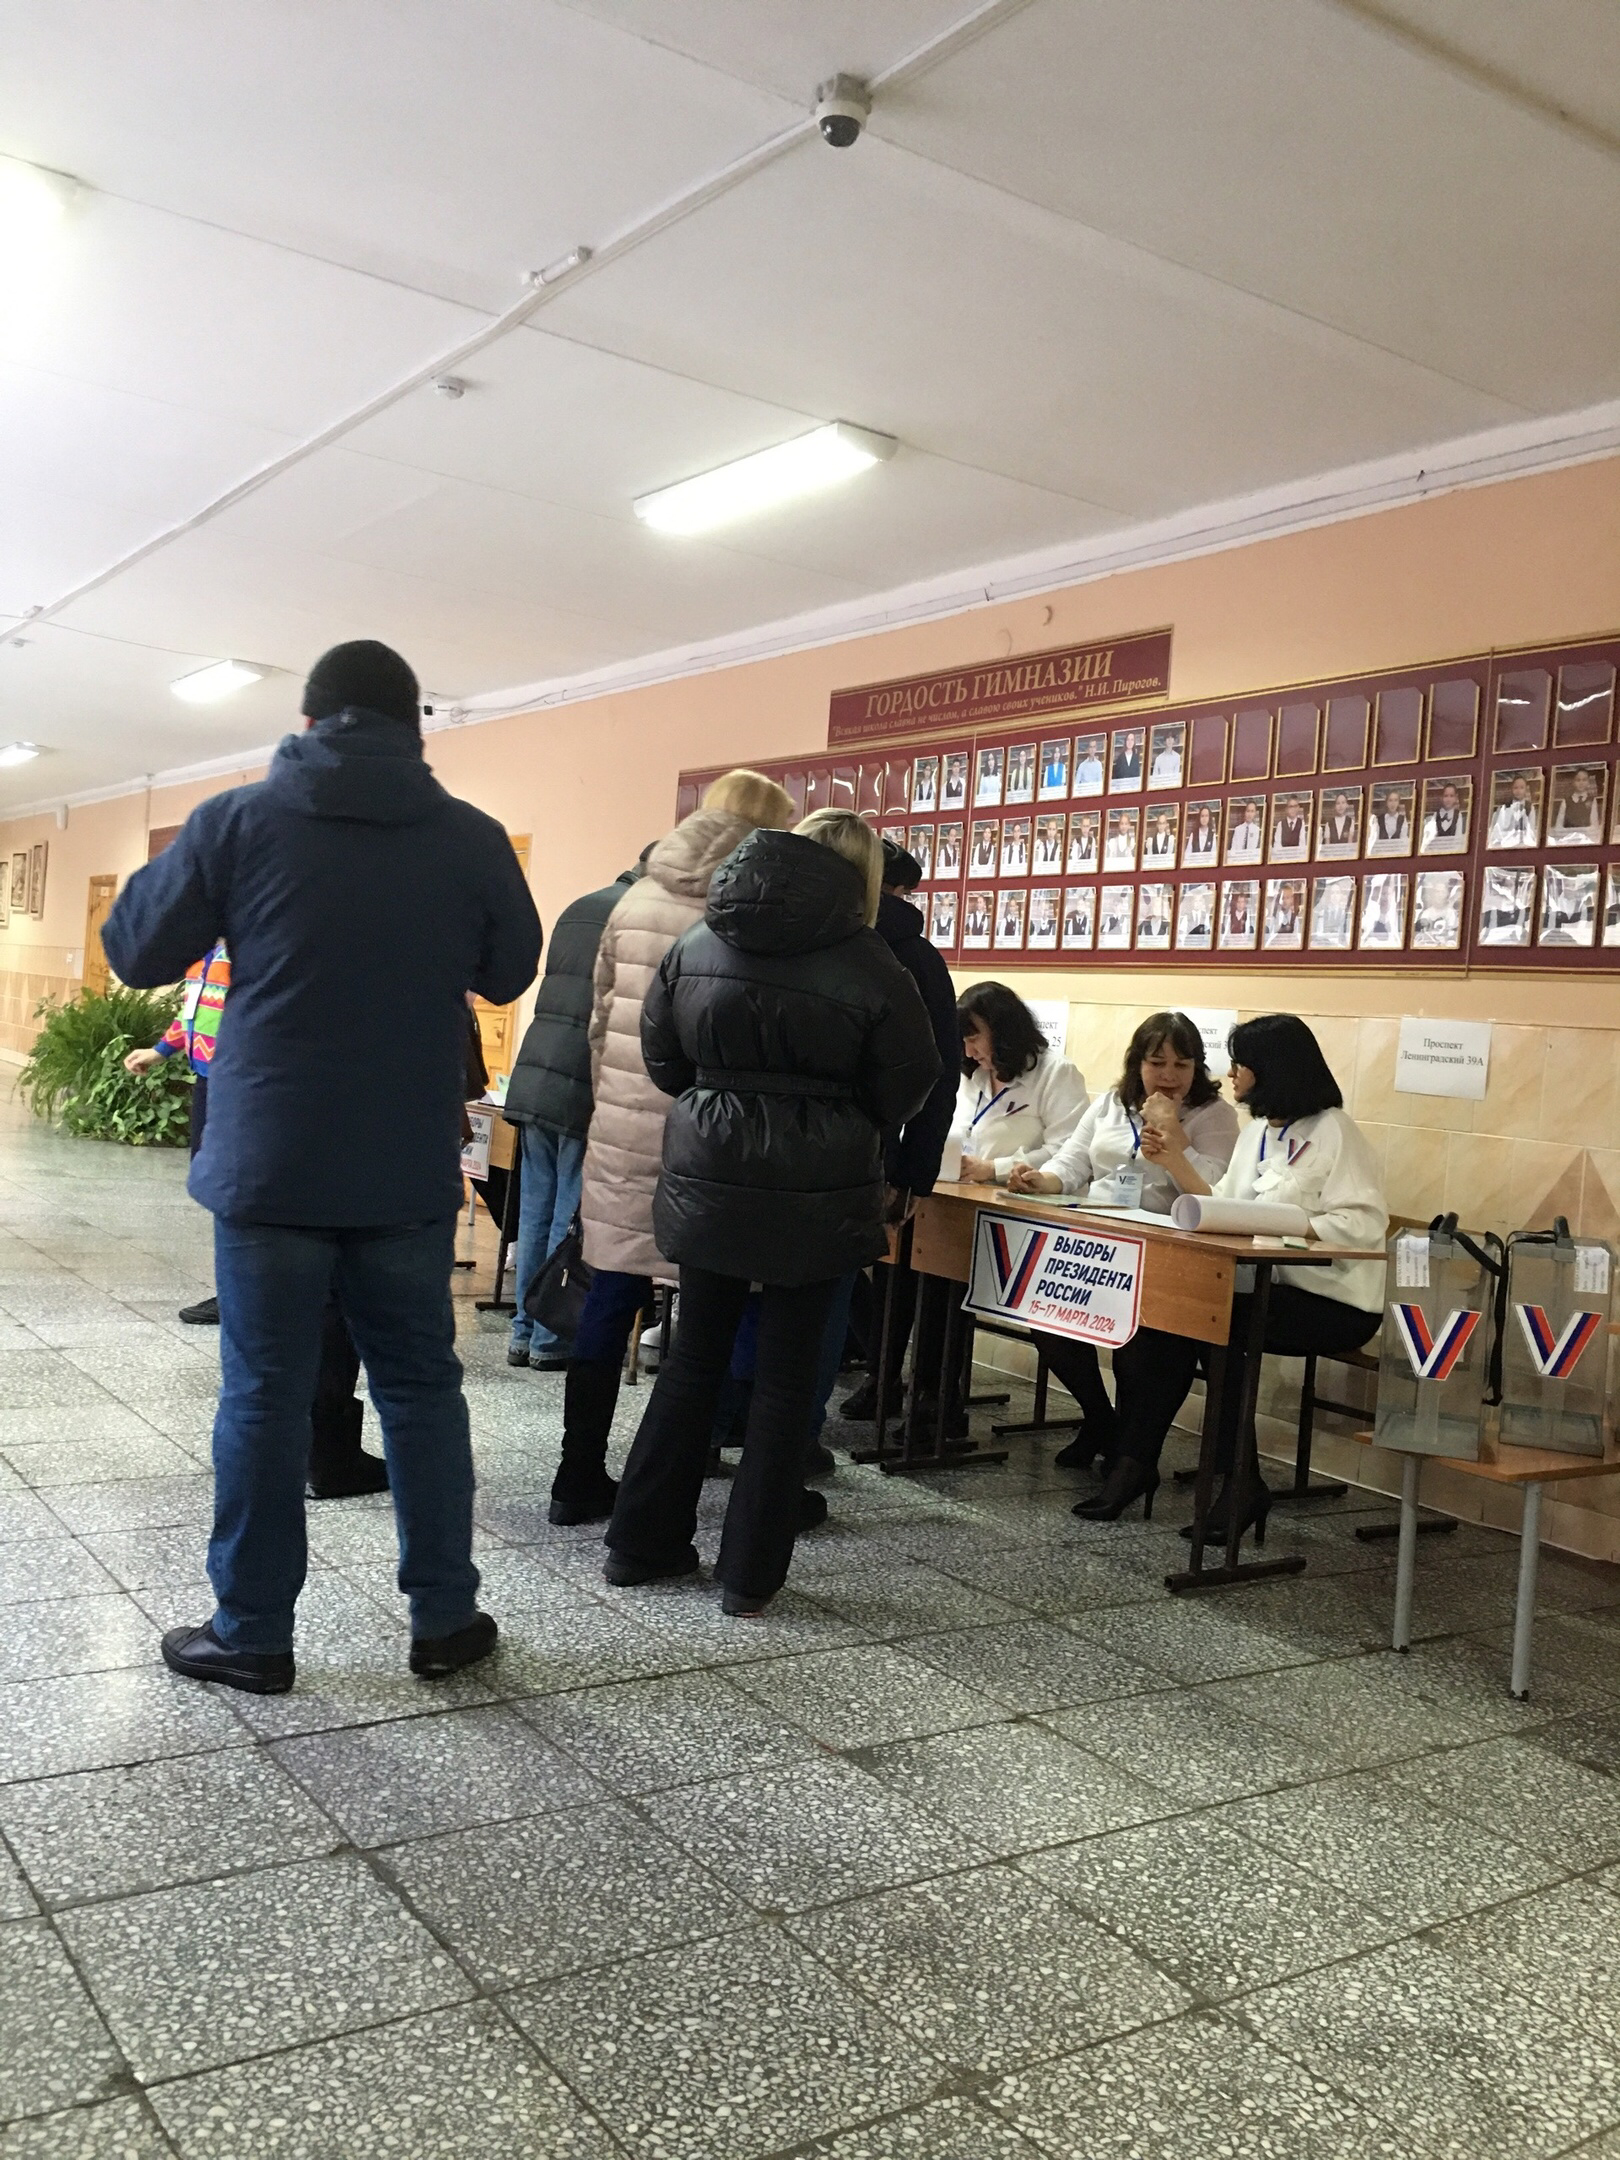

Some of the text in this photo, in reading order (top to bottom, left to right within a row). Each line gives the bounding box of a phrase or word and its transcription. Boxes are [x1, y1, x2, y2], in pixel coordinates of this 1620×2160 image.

[866, 650, 1114, 718] ГОРДОСТЬ ГИМНАЗИИ
[863, 720, 887, 733] школа
[888, 717, 916, 729] славна
[917, 714, 926, 724] не
[928, 710, 960, 723] числом,
[961, 709, 967, 718] а
[968, 703, 1001, 717] славою
[1003, 697, 1029, 711] своих
[1084, 682, 1110, 698] Н.И.
[1112, 676, 1162, 695] Пирогов.
[1051, 1036, 1062, 1047] 25
[1423, 1038, 1464, 1050] Проспект
[1400, 1050, 1484, 1066] Ленинградский 39А
[1053, 1235, 1117, 1262] ВЫБОРЫ
[1044, 1258, 1134, 1292] ПРЕЗИДЕНТА
[1035, 1279, 1093, 1306] РОССИИ
[1055, 1307, 1091, 1327] МАРТА
[1090, 1314, 1116, 1334] 2024
